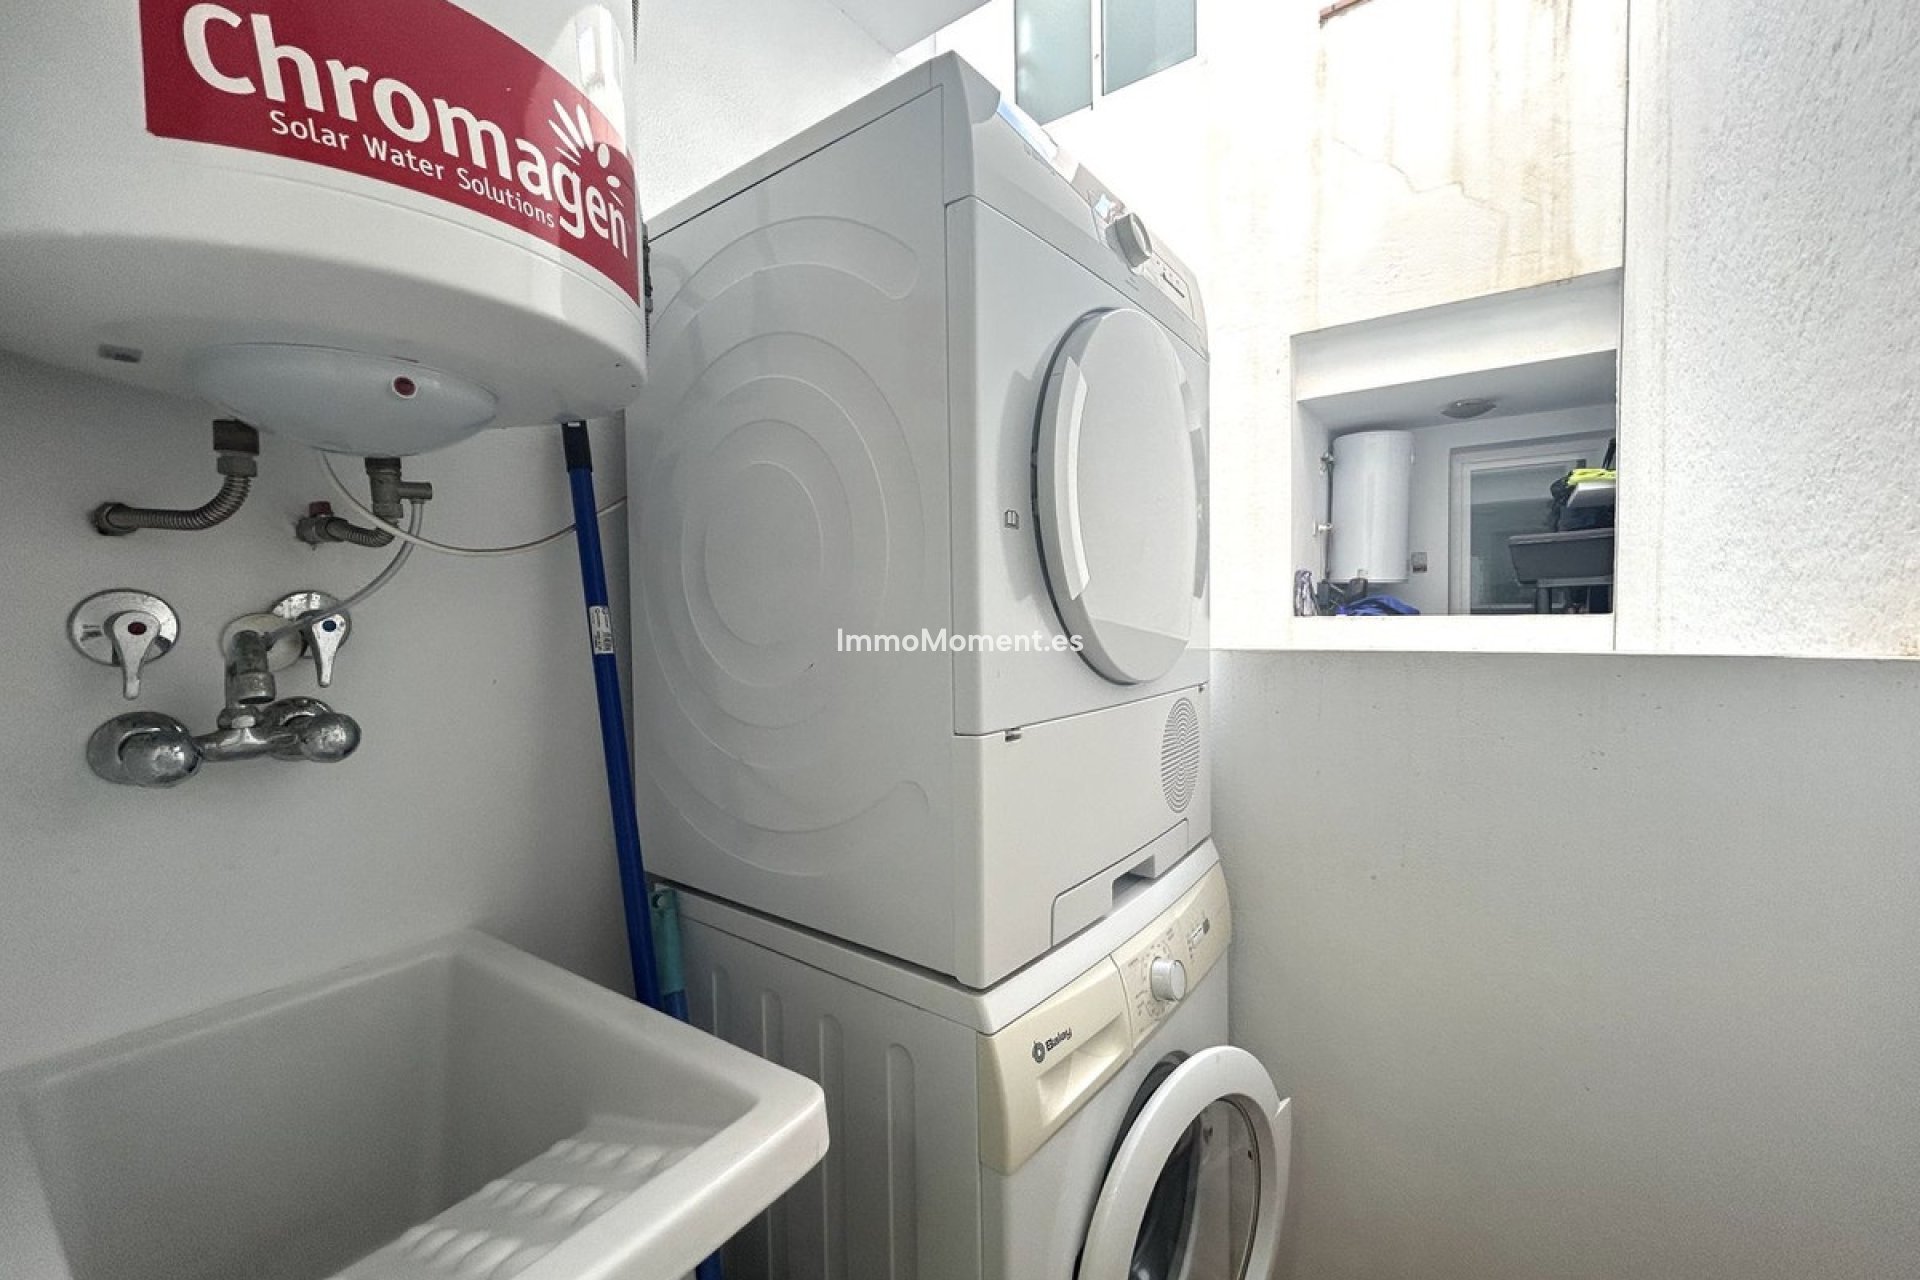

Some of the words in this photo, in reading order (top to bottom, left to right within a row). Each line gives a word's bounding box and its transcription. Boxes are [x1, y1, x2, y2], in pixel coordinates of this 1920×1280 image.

[183, 4, 628, 258] Chromagen
[270, 110, 349, 151] Solar
[363, 134, 444, 180] Water
[457, 167, 554, 229] Solutions
[1045, 1028, 1072, 1051] Balay
